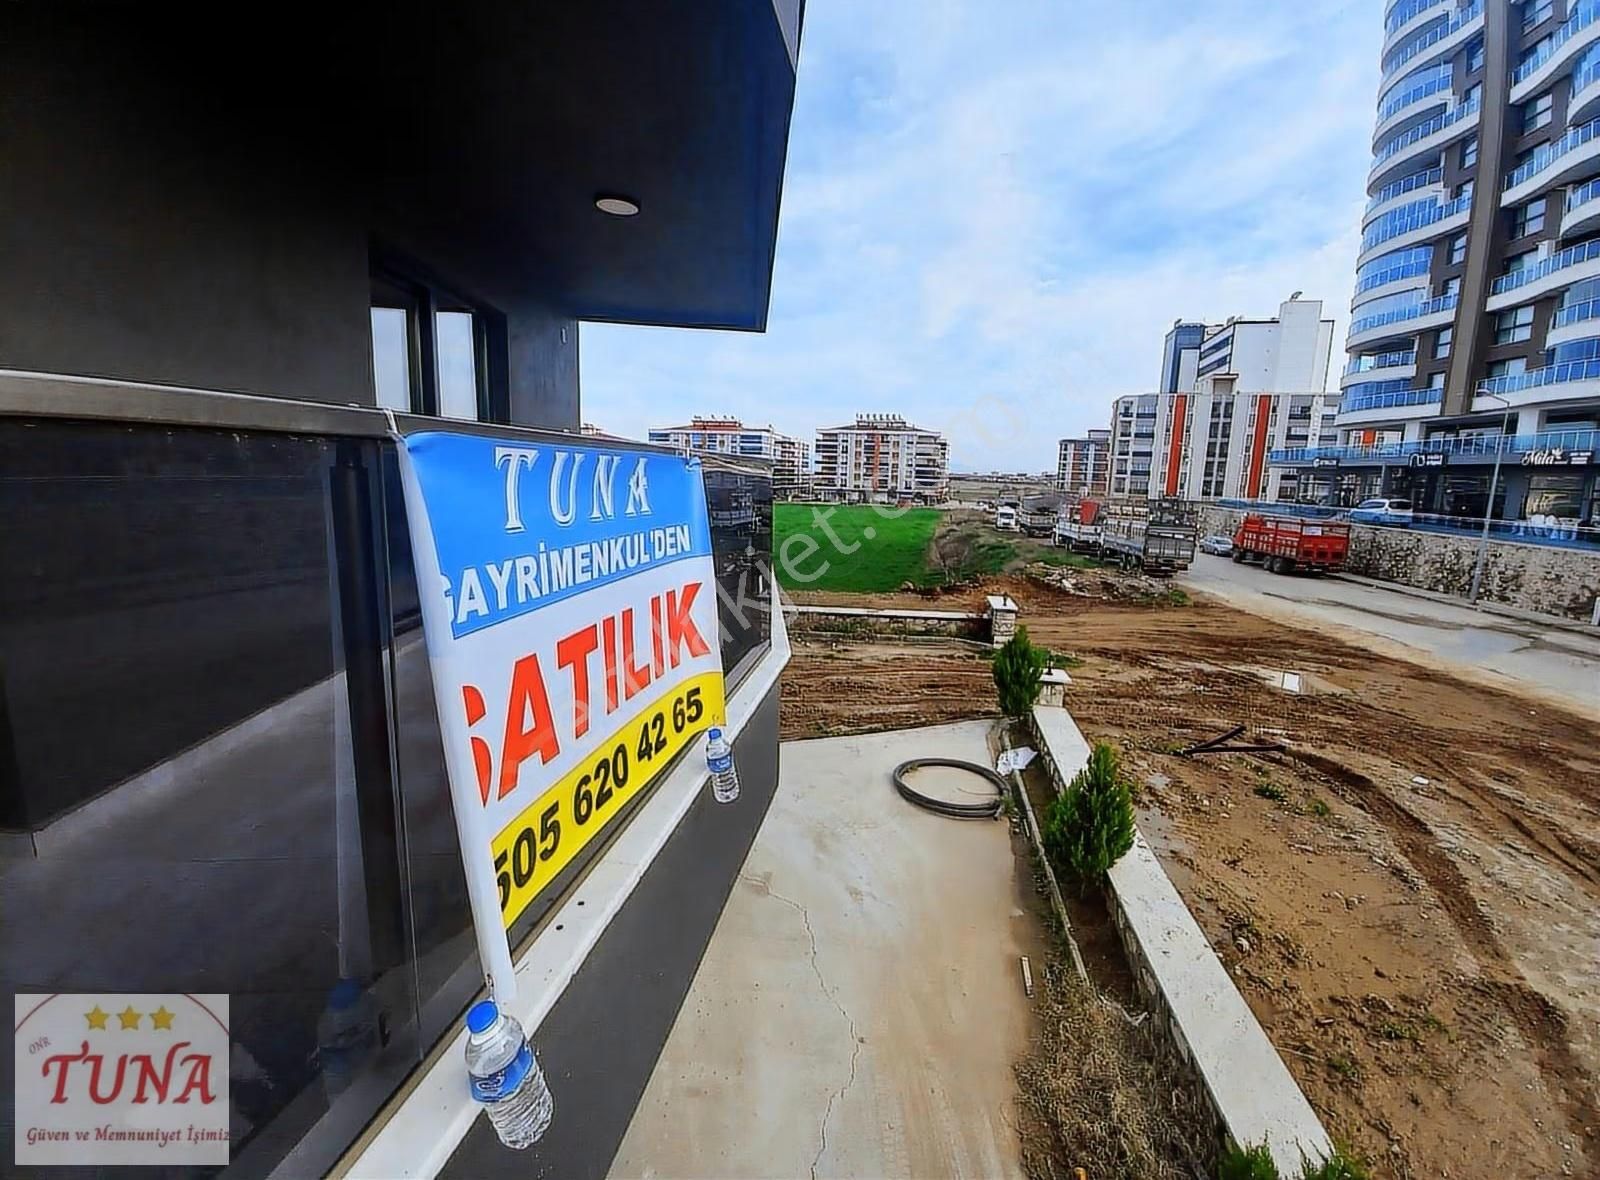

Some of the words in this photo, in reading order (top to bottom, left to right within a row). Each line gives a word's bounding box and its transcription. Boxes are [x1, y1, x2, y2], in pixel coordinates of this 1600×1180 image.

[494, 446, 654, 534] TUNA
[573, 743, 630, 827] 620
[637, 711, 669, 763] 42
[672, 686, 704, 734] 65
